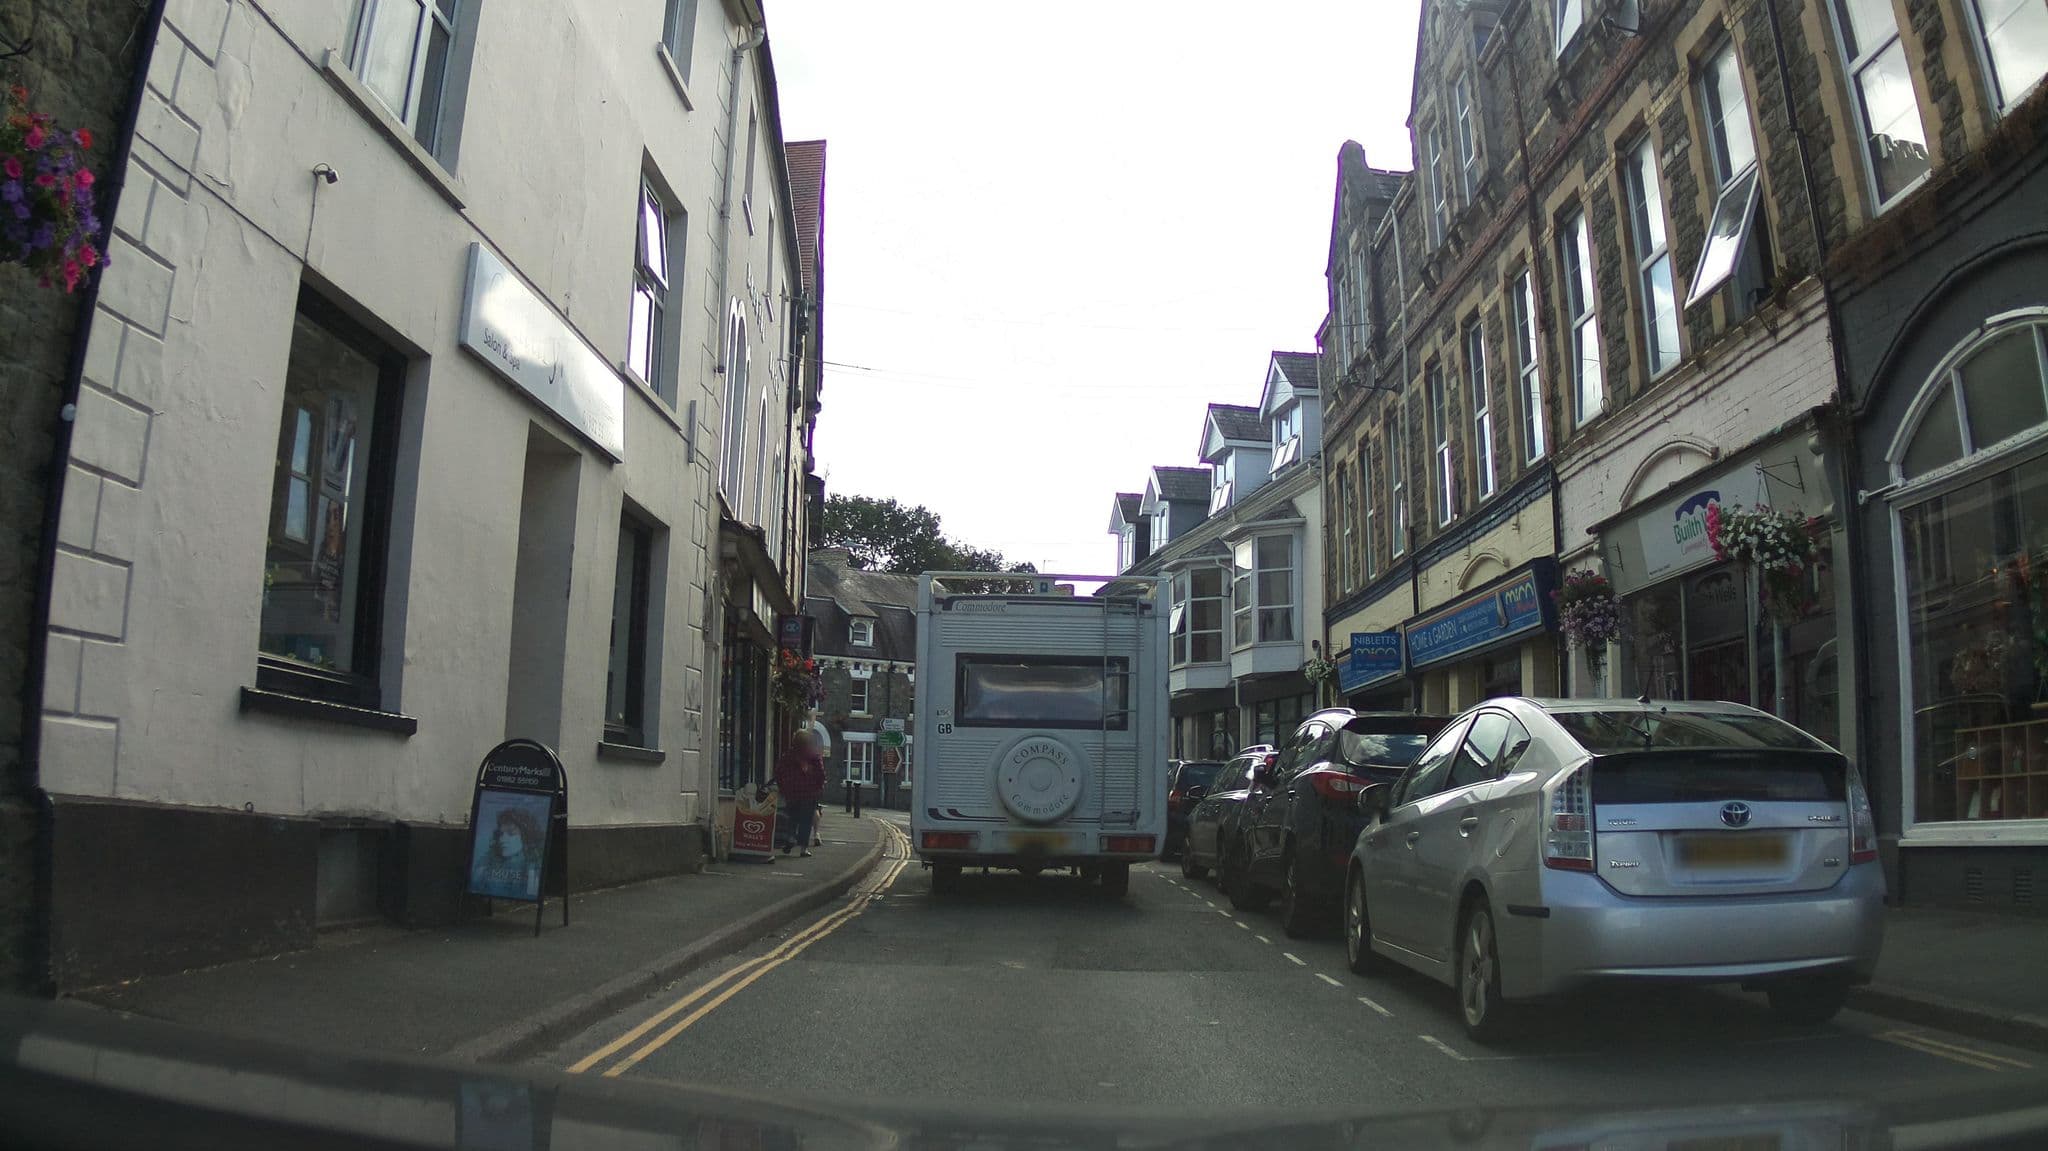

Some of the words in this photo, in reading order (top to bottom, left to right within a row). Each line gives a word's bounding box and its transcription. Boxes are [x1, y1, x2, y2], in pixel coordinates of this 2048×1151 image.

[483, 326, 503, 356] Salon
[502, 343, 509, 361] &
[1673, 515, 1703, 546] Builth
[955, 602, 1007, 613] Commodore
[1353, 635, 1397, 646] NIBLETTS
[1432, 618, 1458, 646] GARDEN
[937, 724, 953, 735] GB
[1012, 744, 1070, 766] COMPASS
[1011, 793, 1070, 814] Commodore
